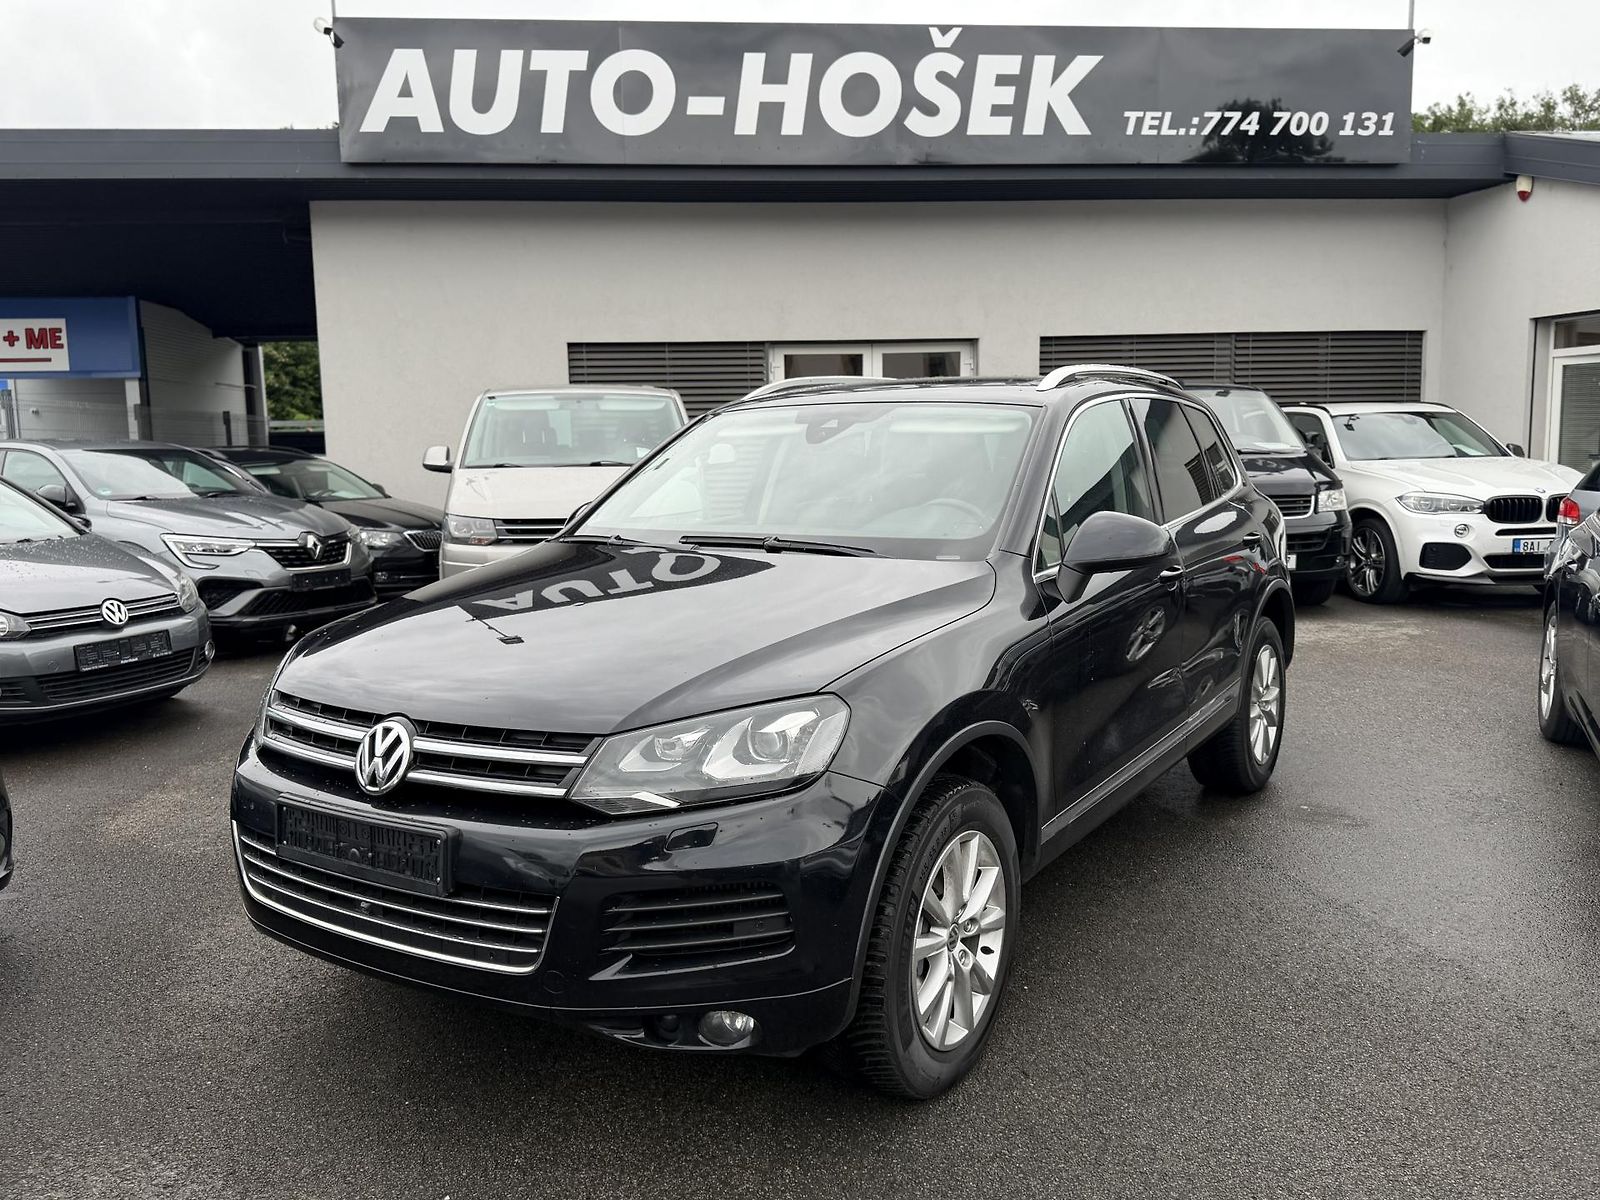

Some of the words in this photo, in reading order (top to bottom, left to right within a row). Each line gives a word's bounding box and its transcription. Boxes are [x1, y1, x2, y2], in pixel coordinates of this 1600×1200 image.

[359, 27, 1104, 137] AUTO-HOŠEK
[1269, 111, 1329, 136] 700
[1339, 111, 1395, 136] 131
[25, 328, 64, 349] ME
[102, 600, 128, 624] VW
[356, 717, 410, 792] VW
